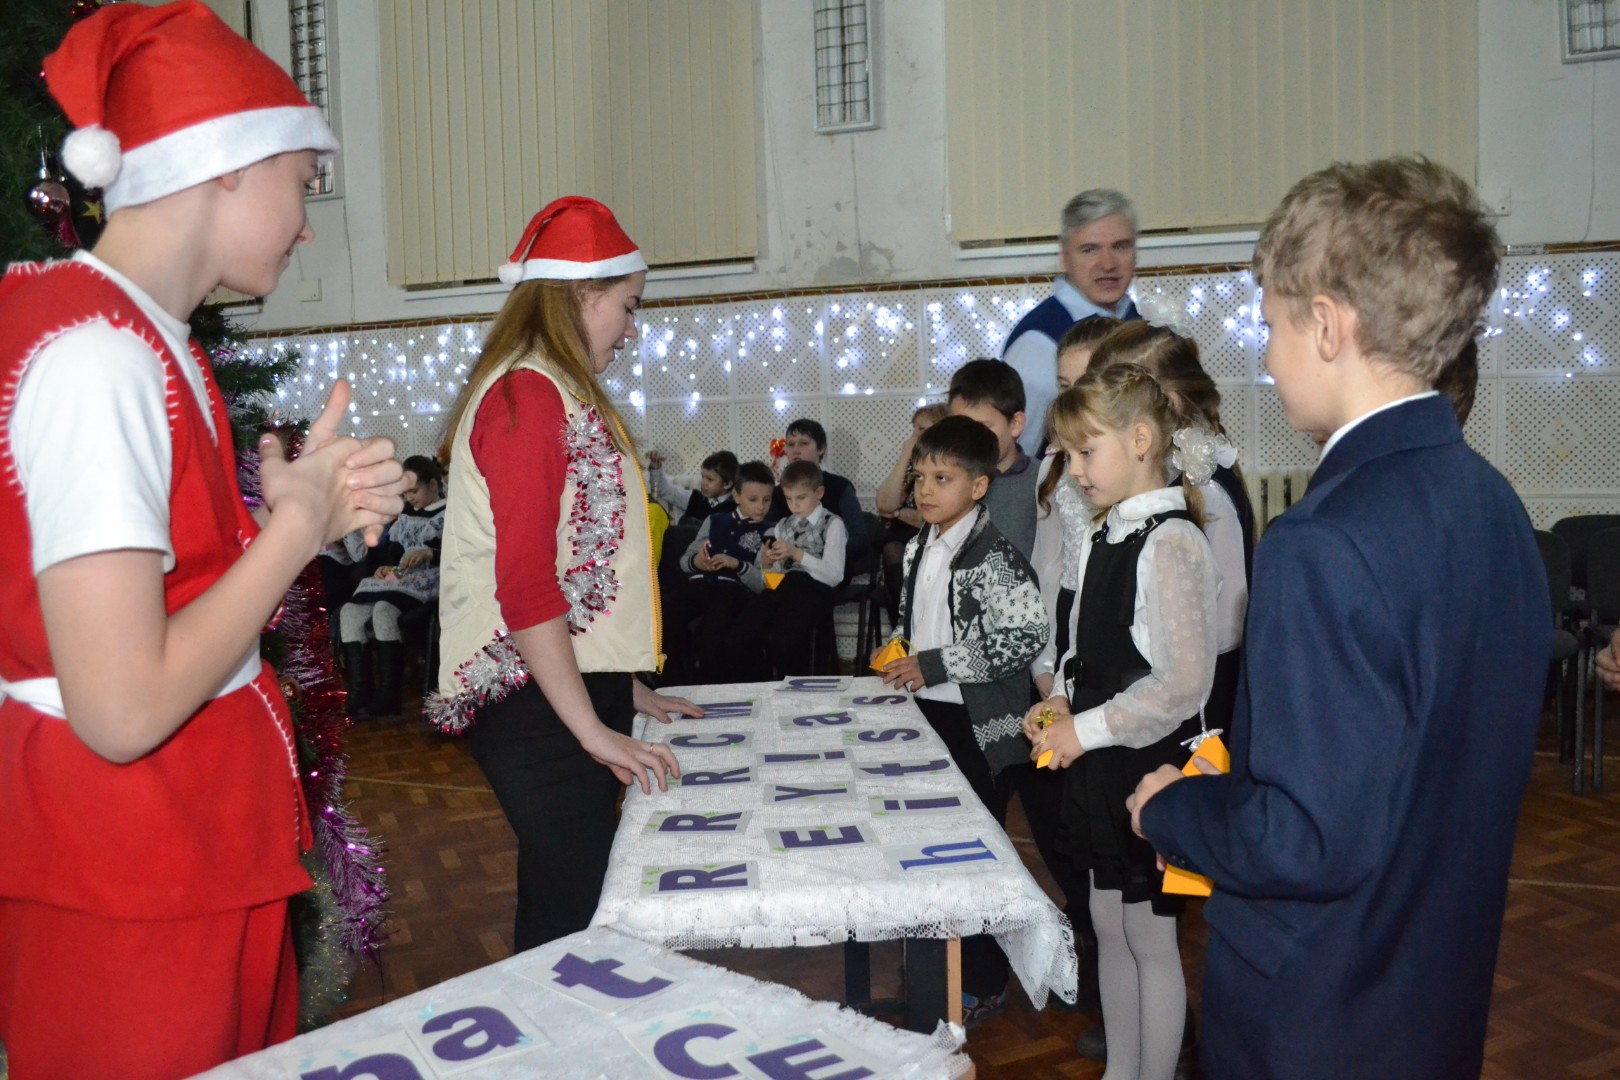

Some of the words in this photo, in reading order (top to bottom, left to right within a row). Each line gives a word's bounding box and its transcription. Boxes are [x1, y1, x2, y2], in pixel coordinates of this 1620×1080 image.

[793, 711, 853, 727] a
[681, 766, 751, 786] R
[859, 758, 951, 777] t
[774, 785, 848, 802] Y
[658, 811, 743, 832] R
[779, 825, 865, 850] E
[899, 838, 998, 871] h
[658, 862, 749, 892] R
[551, 952, 674, 999] t
[422, 1006, 526, 1062] a
